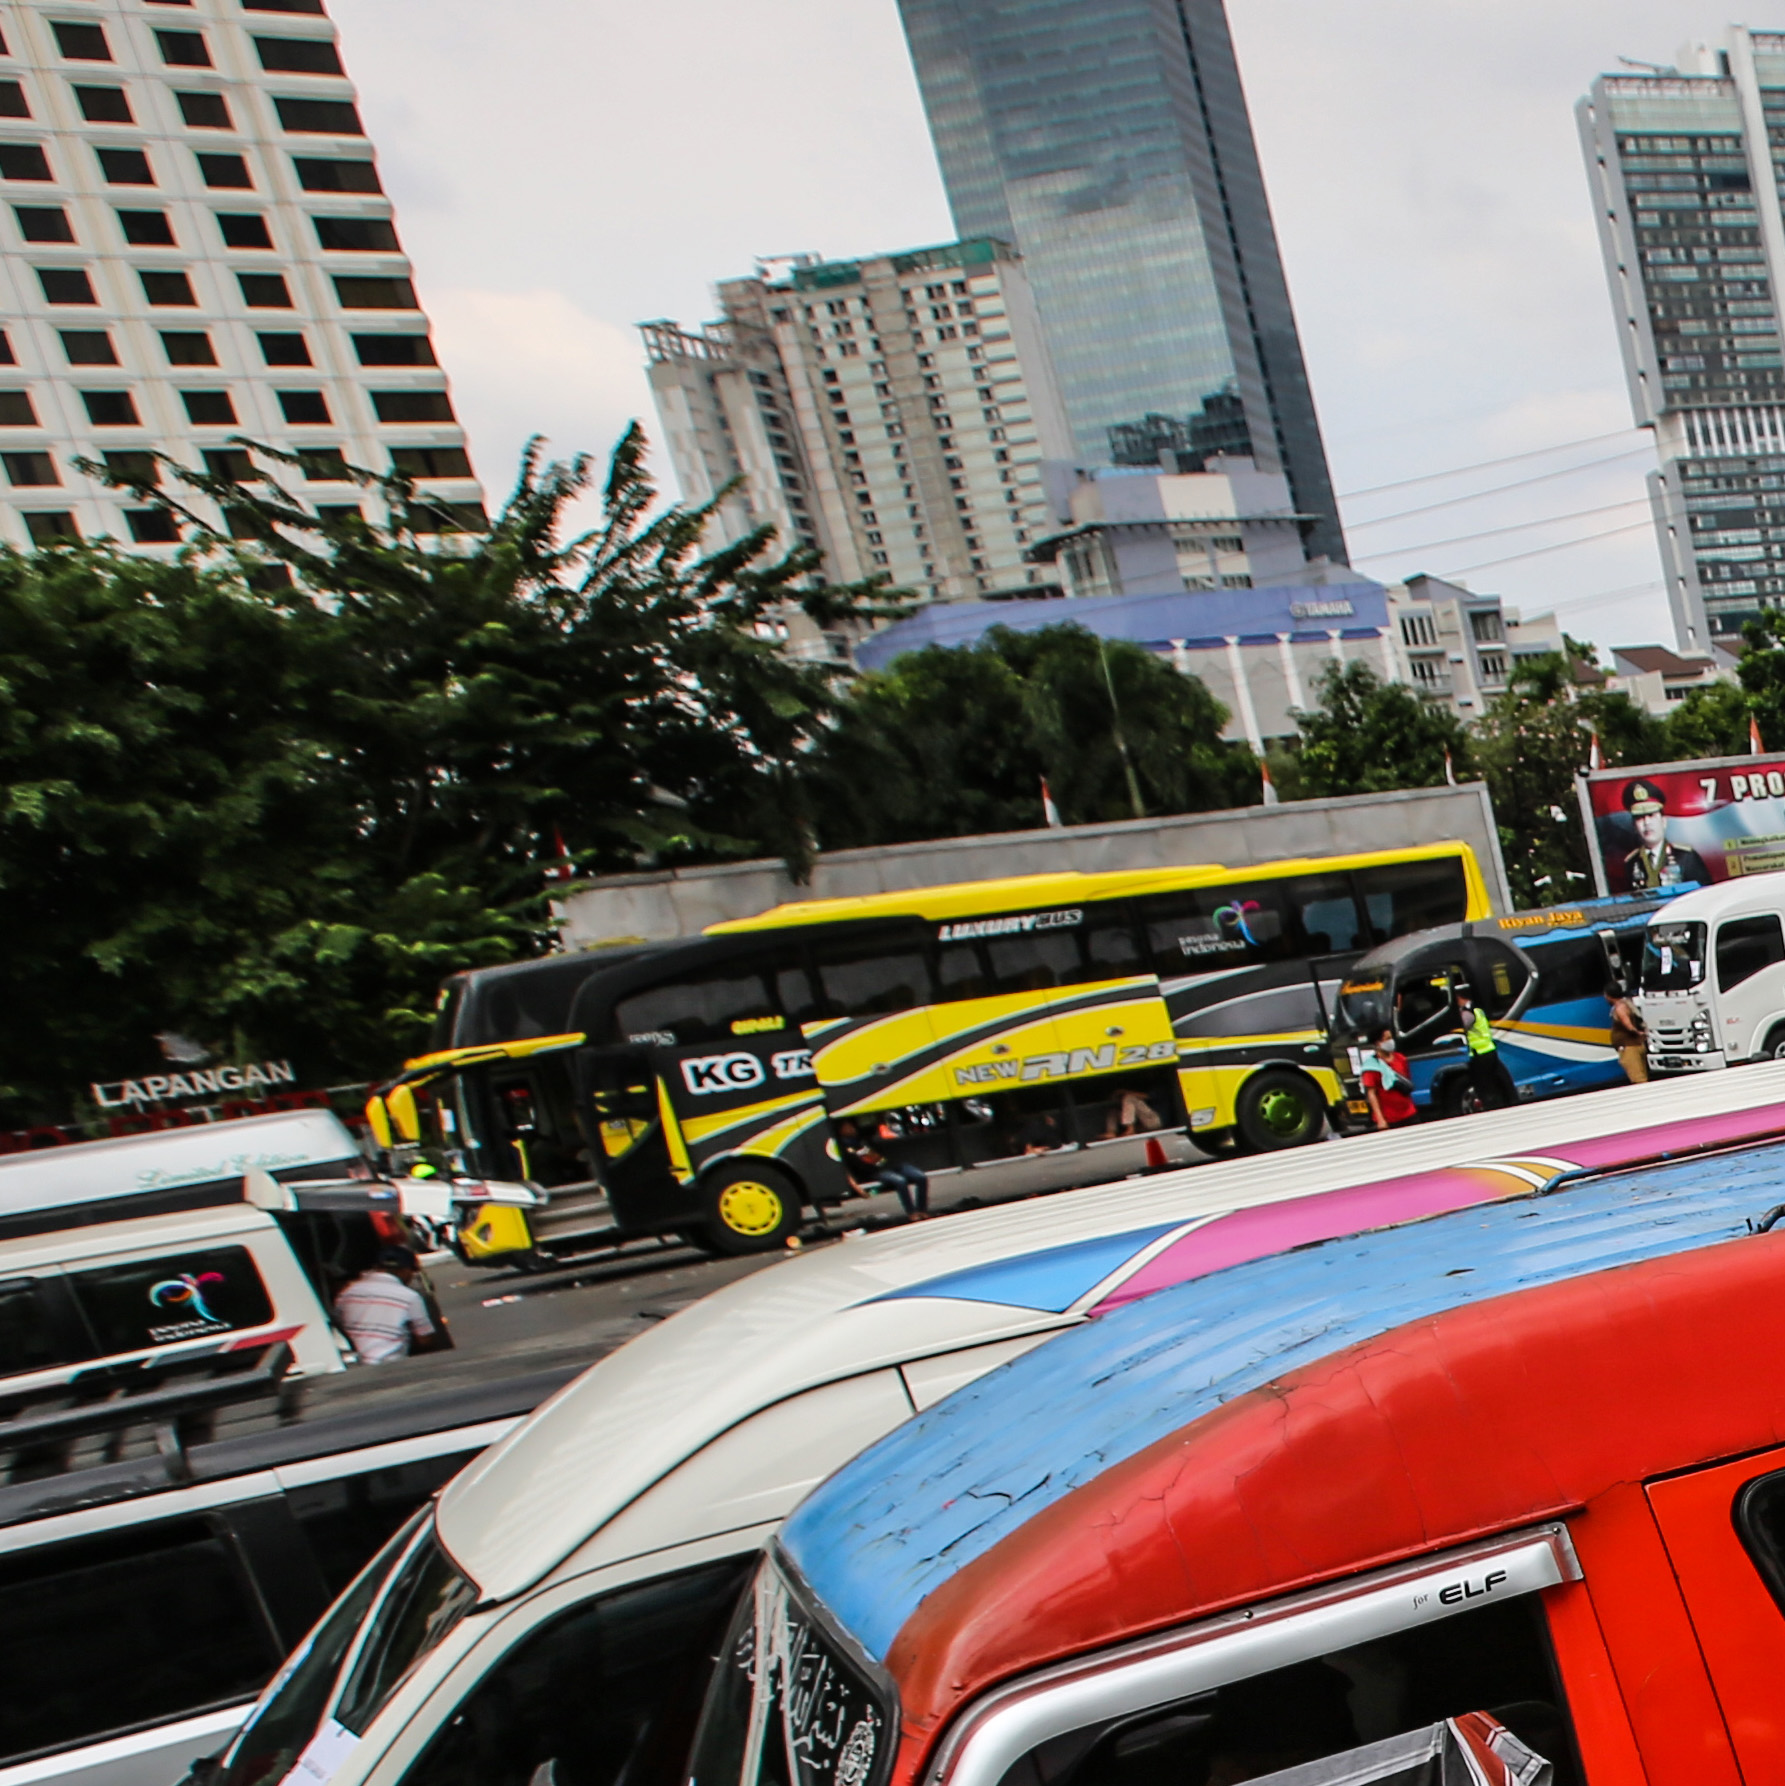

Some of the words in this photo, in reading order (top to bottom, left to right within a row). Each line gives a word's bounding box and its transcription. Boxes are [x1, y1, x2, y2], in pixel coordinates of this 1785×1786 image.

[1306, 601, 1353, 617] YAMAHA
[1700, 778, 1717, 803] 7
[1499, 914, 1544, 930] Riyan
[92, 1061, 296, 1108] LAPANGAN
[684, 1054, 761, 1092] KG
[954, 1058, 1018, 1087] NEW
[1412, 1594, 1429, 1610] for
[1439, 1569, 1507, 1605] ELF
